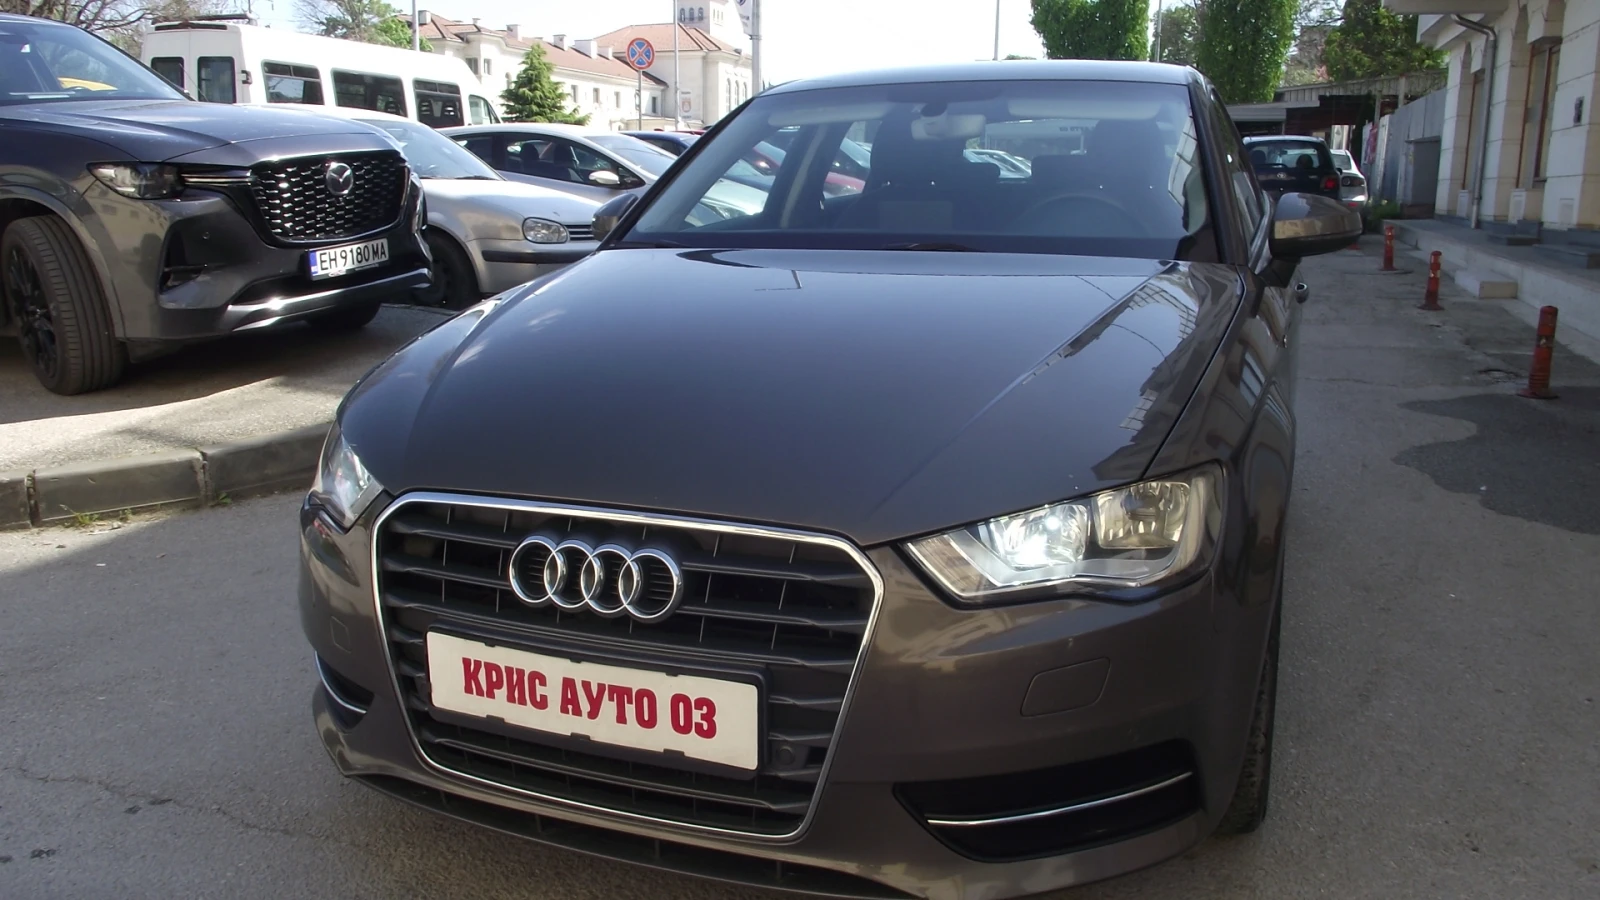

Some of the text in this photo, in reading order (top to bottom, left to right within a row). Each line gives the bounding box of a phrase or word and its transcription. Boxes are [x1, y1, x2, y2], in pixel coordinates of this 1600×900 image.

[319, 241, 387, 271] EH 9180 MA
[461, 656, 717, 740] КРИС АУТО 03
